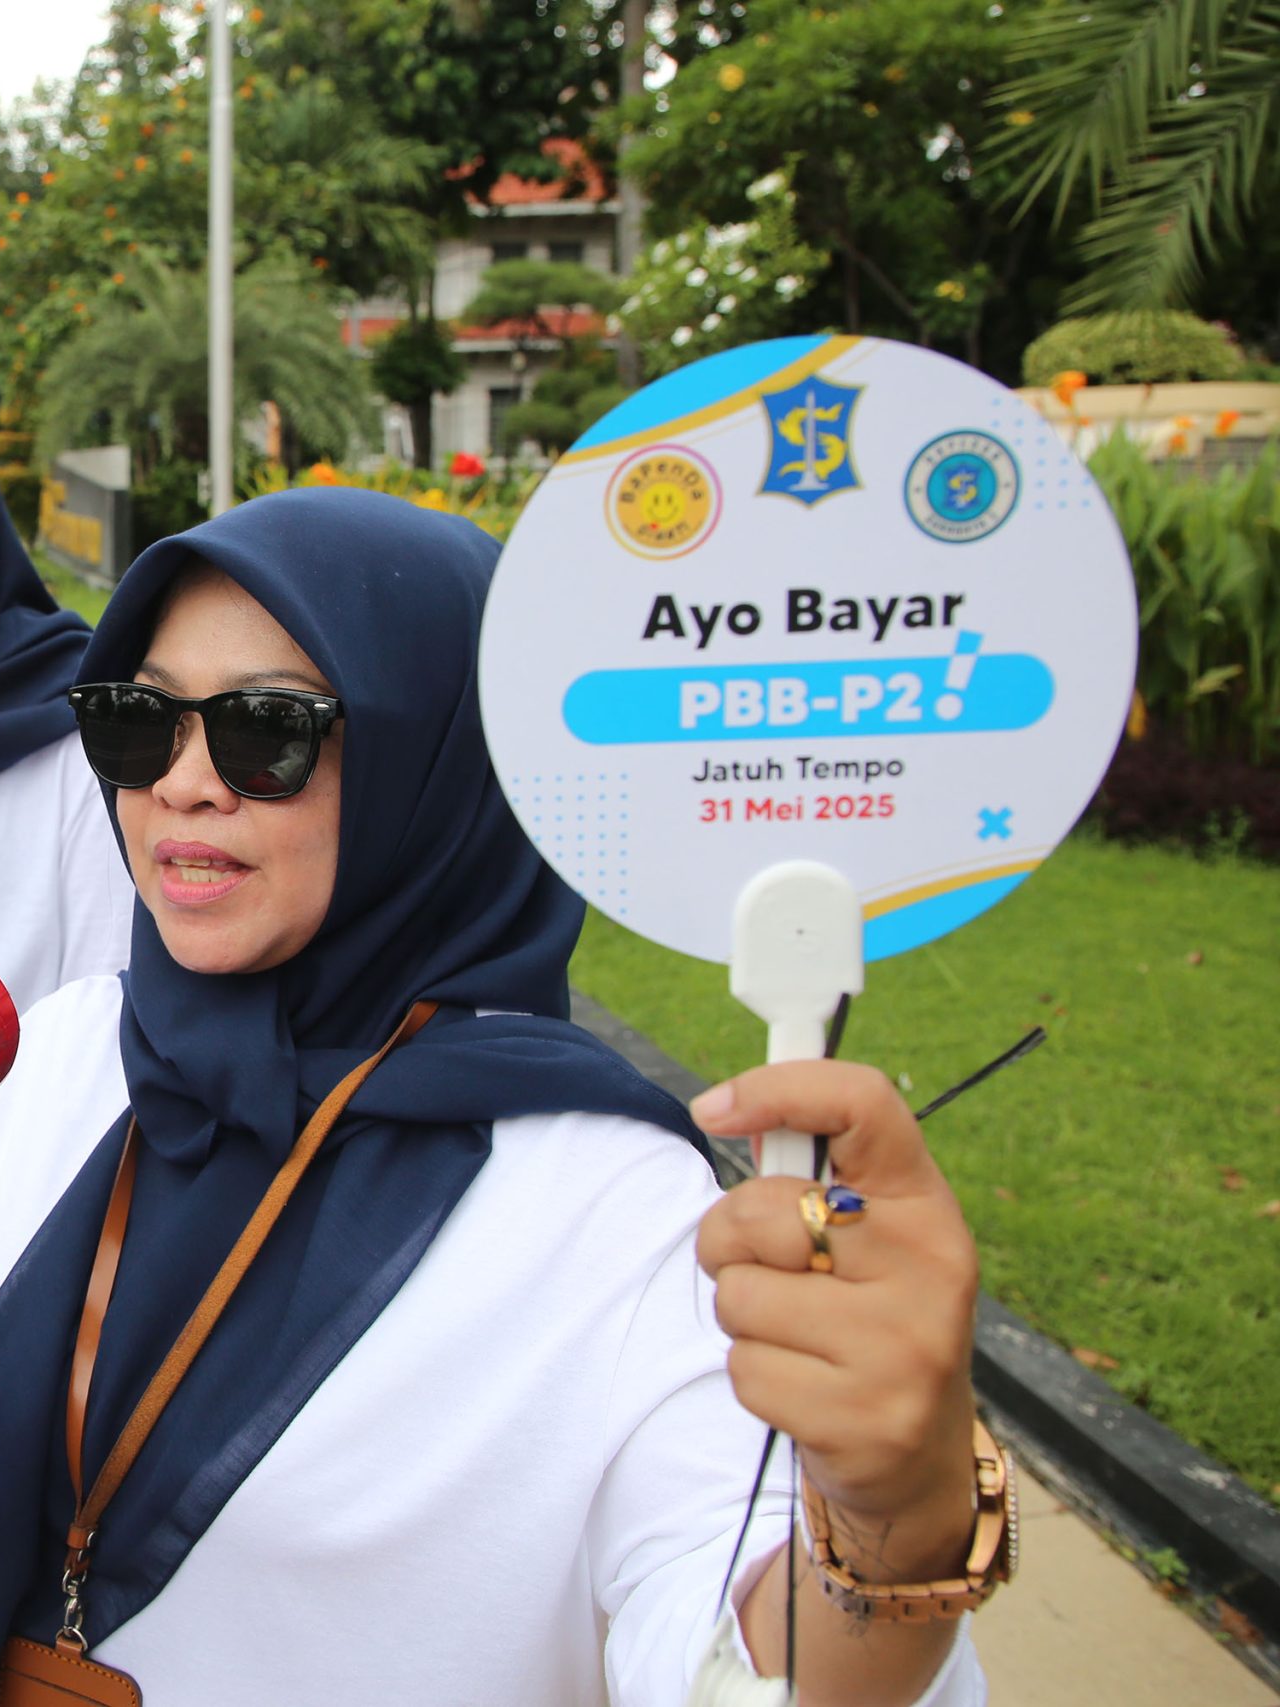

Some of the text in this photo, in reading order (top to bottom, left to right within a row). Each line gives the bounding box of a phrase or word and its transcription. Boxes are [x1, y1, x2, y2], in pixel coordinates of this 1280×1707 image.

[641, 587, 966, 651] Ayo Bayar
[679, 628, 984, 730] PBB-P2!
[692, 755, 905, 785] Jatuh Tempo
[699, 793, 896, 823] 31 Mei 2025
